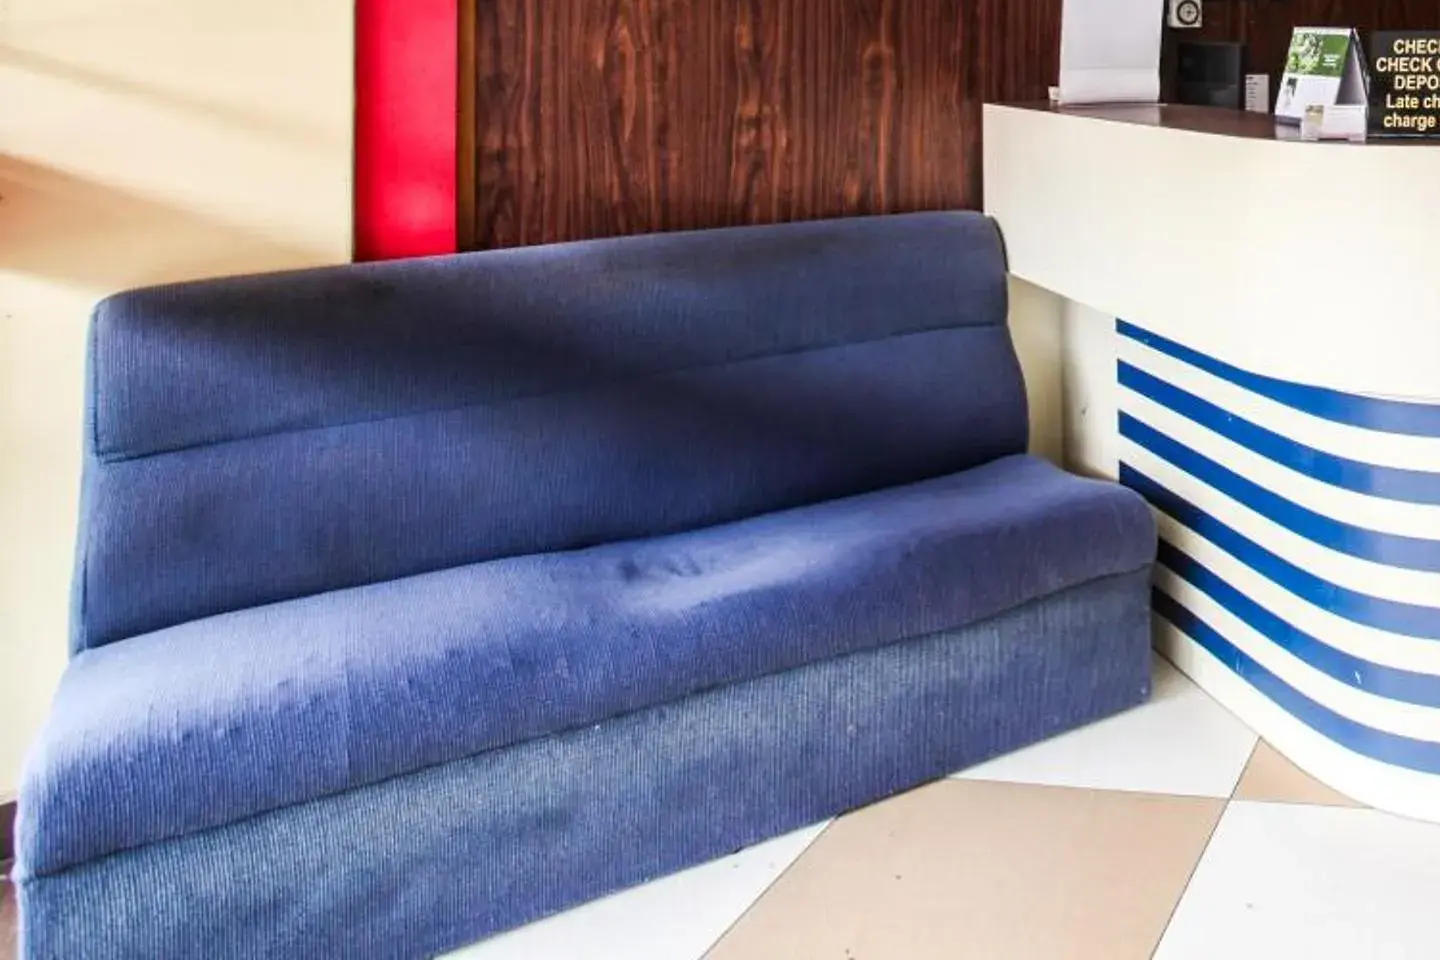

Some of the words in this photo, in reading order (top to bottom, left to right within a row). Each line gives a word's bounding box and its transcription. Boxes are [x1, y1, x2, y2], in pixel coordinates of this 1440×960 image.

[1376, 57, 1434, 72] CHECK
[1386, 94, 1420, 109] Late
[1383, 114, 1435, 130] charge
